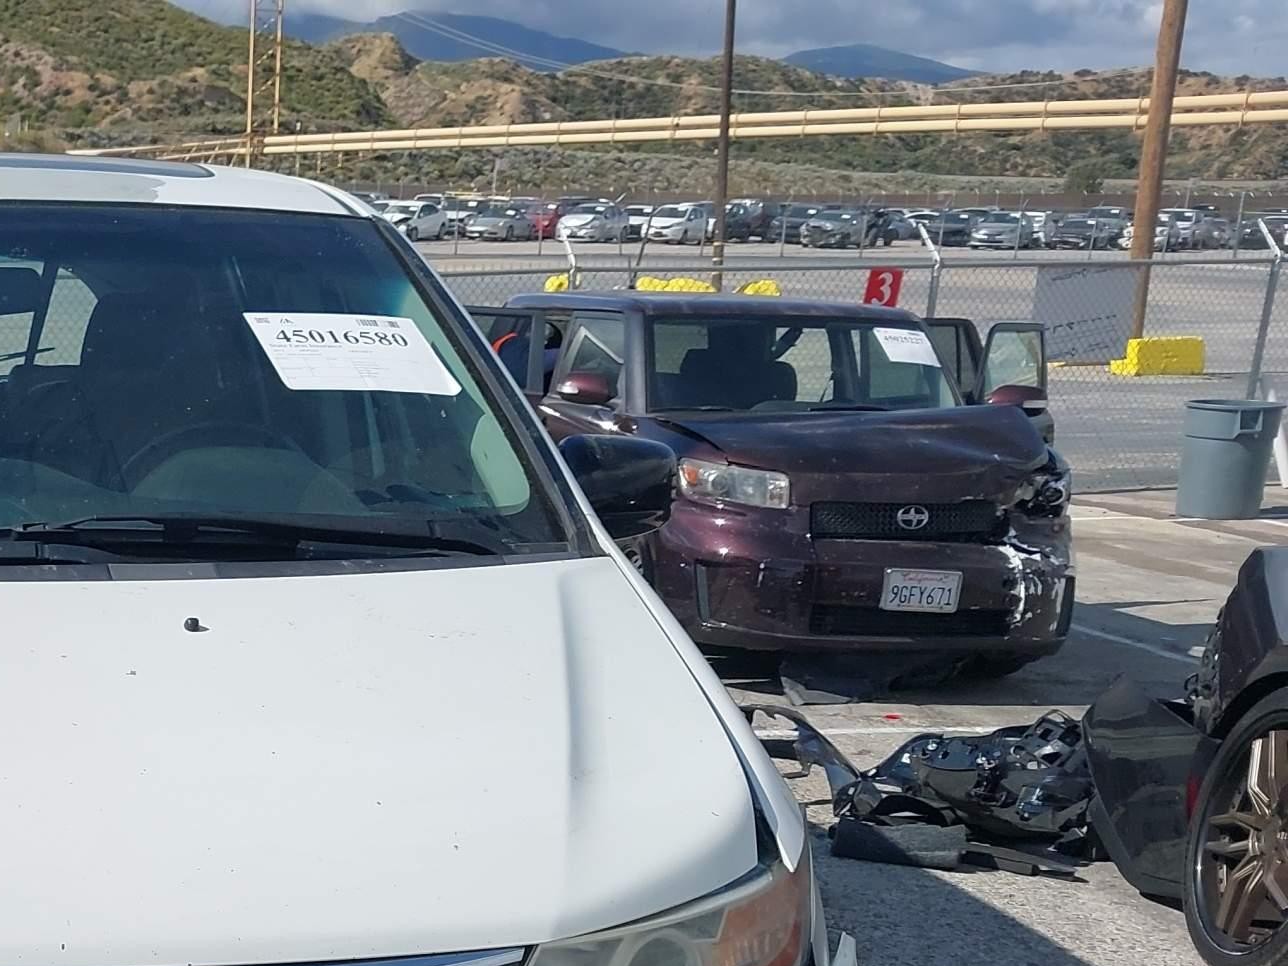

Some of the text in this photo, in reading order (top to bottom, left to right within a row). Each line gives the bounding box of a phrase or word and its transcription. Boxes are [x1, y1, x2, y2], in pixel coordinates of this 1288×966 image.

[871, 271, 893, 305] 3
[275, 329, 409, 348] 45016580
[889, 585, 952, 606] 9GFY671
